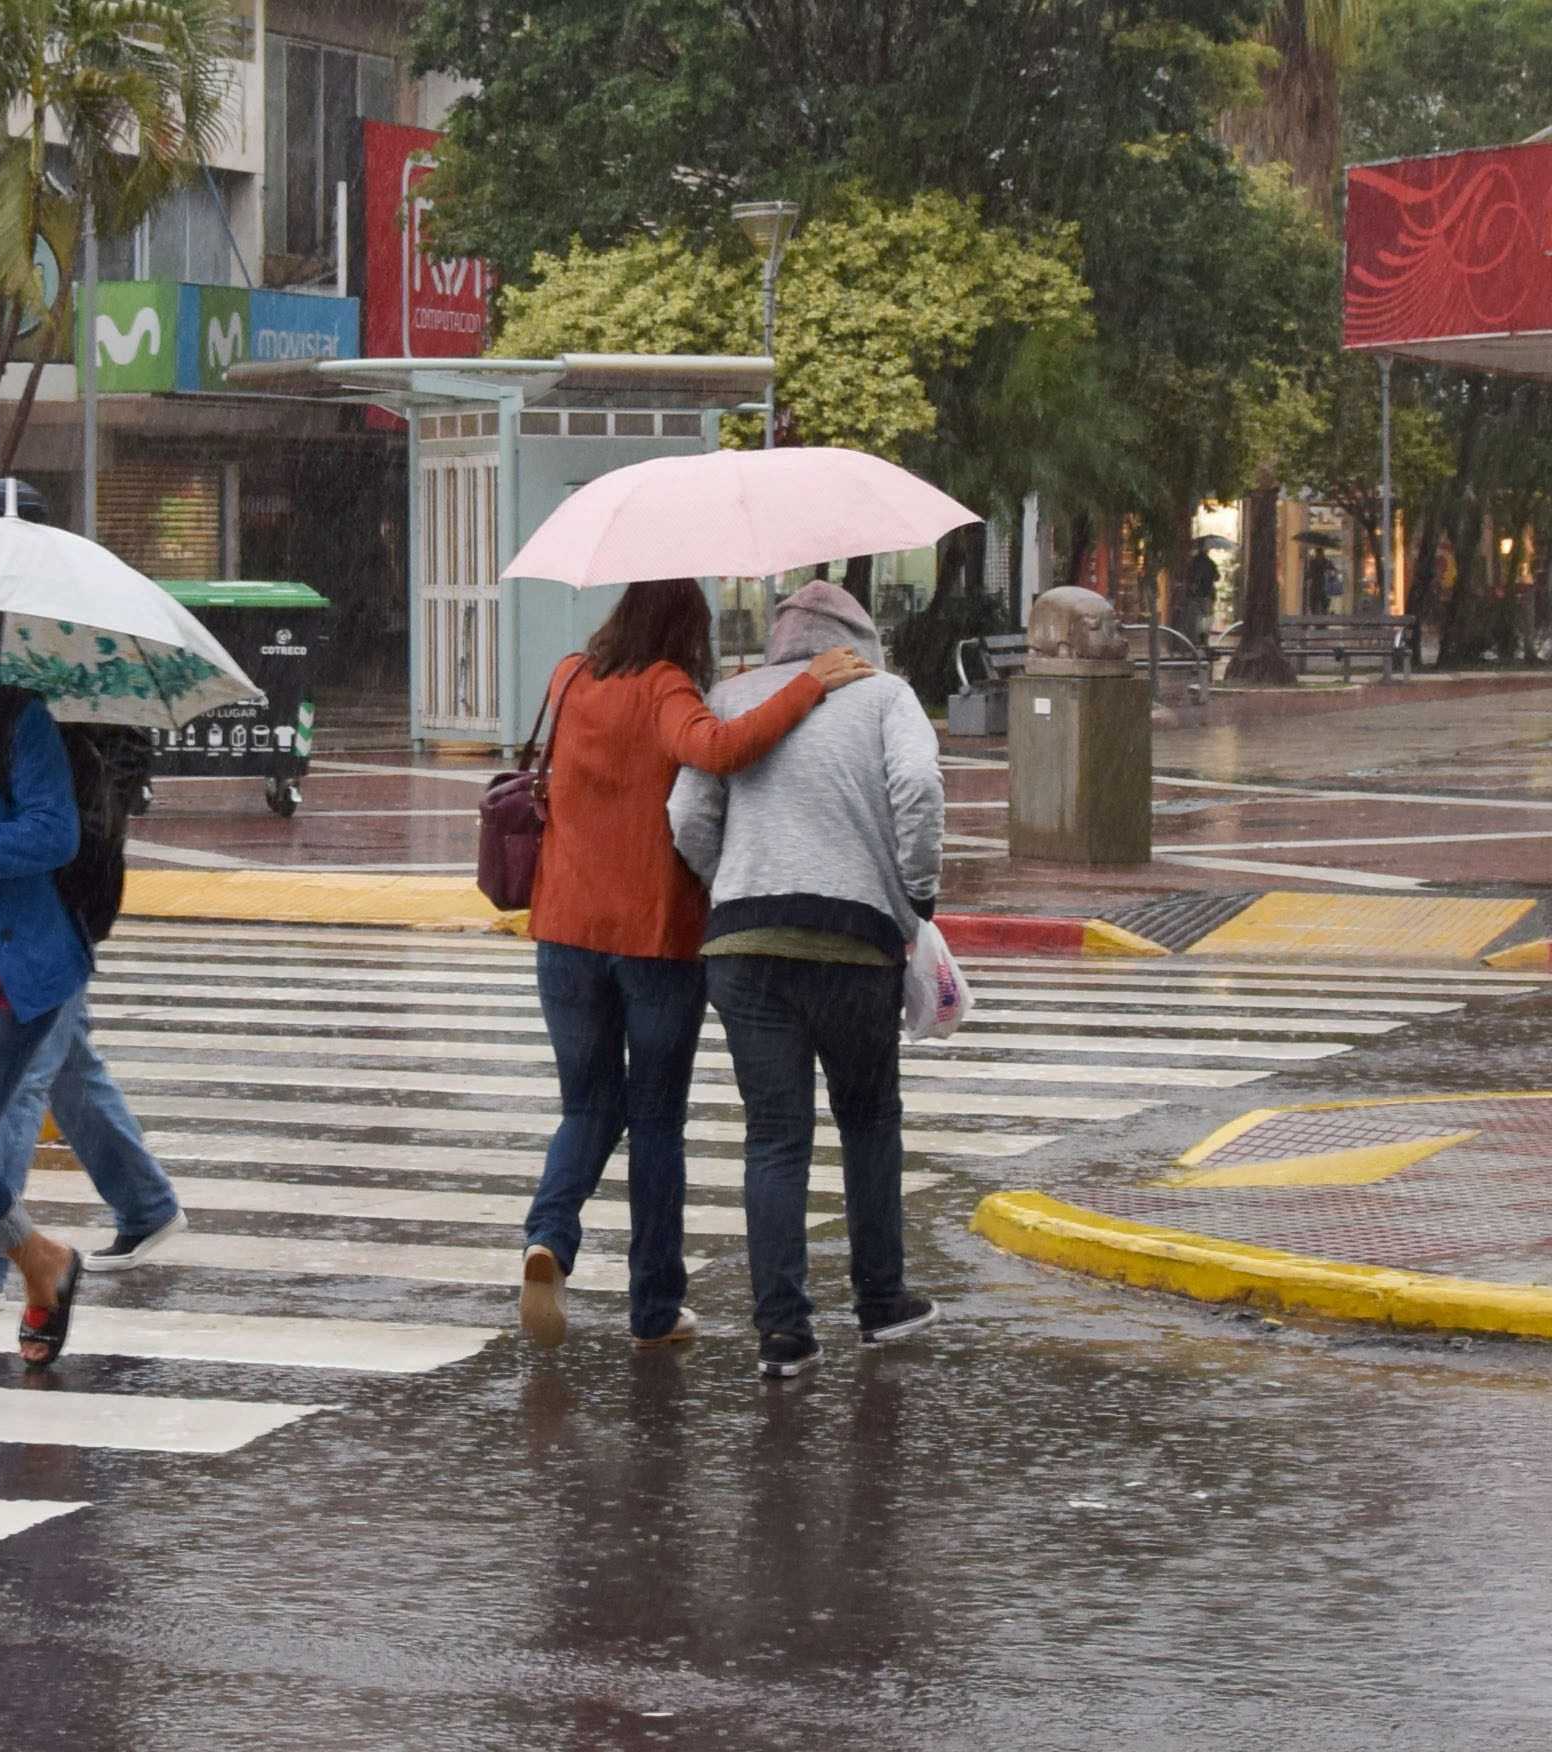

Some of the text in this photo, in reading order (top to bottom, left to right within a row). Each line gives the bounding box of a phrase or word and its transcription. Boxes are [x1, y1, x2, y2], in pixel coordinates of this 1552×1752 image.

[257, 317, 340, 361] movistar
[260, 645, 308, 656] COTRECO
[217, 707, 257, 720] LUGAR
